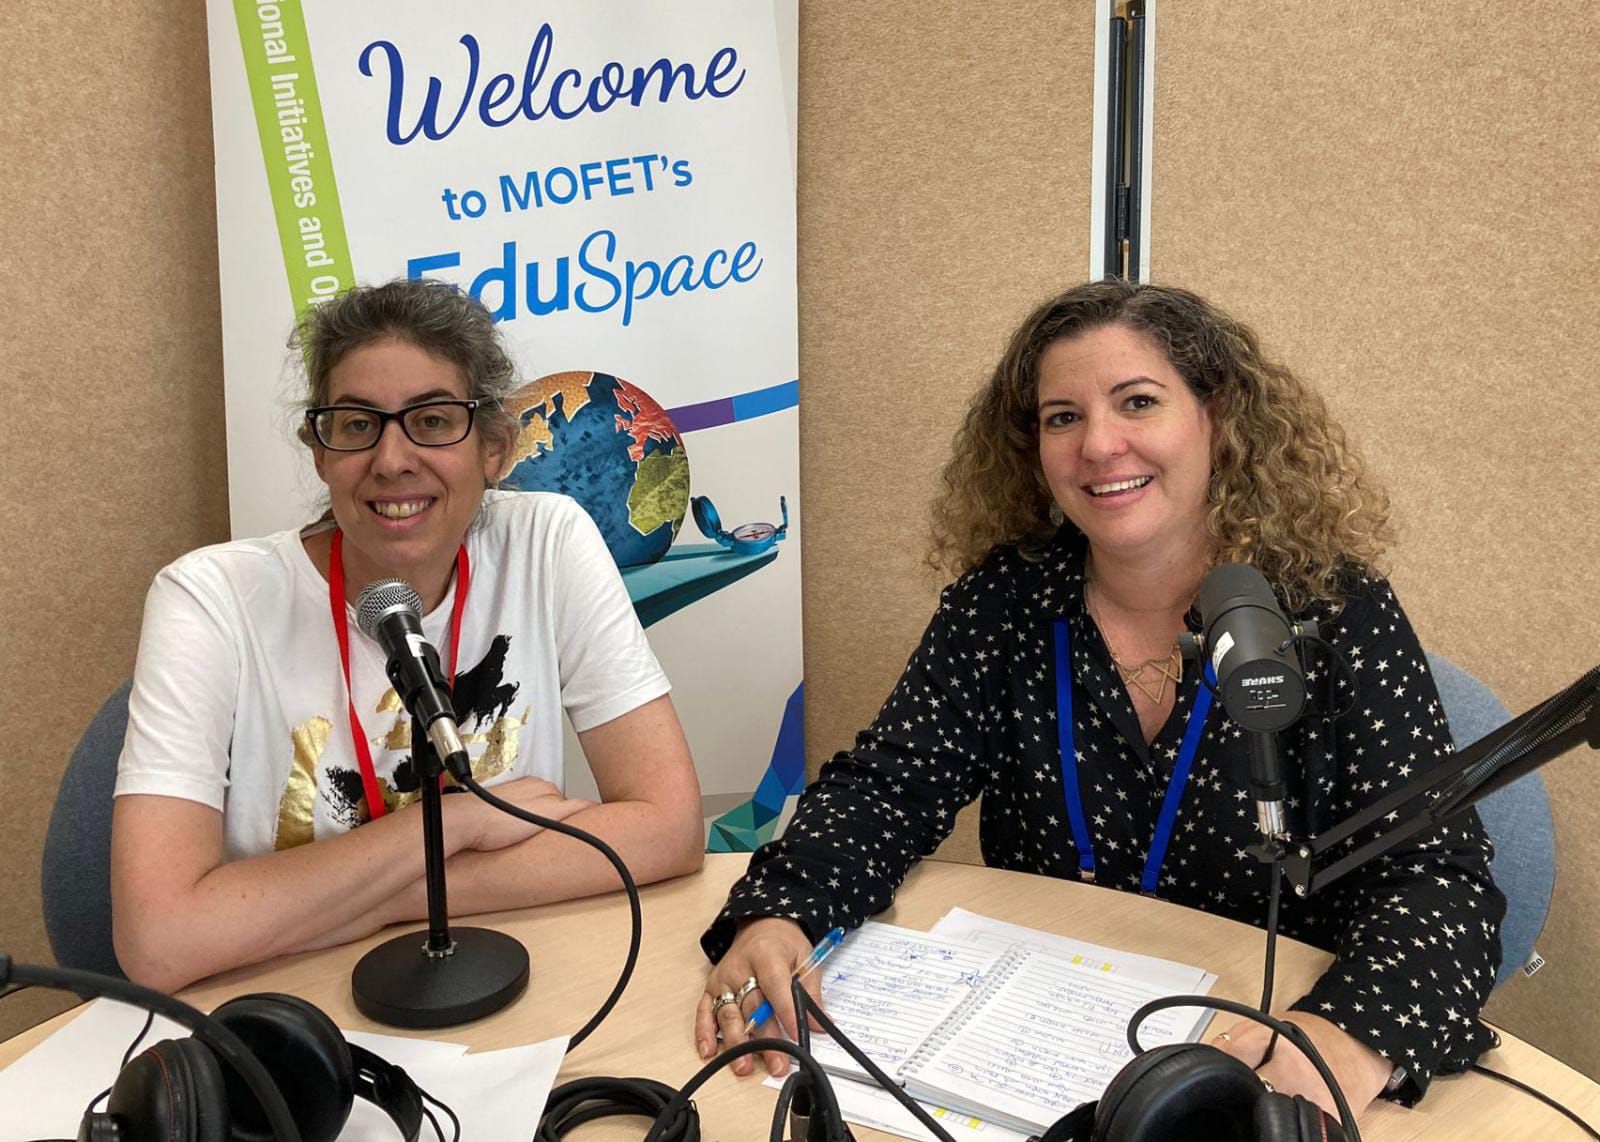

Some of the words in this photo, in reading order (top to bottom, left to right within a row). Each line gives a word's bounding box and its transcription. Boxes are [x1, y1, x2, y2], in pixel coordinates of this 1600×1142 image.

[359, 23, 746, 146] Welcome
[271, 73, 317, 208] Initiatives
[299, 216, 335, 267] and
[442, 187, 487, 220] to
[499, 154, 693, 213] MOFET's
[1241, 675, 1284, 687] SHURE
